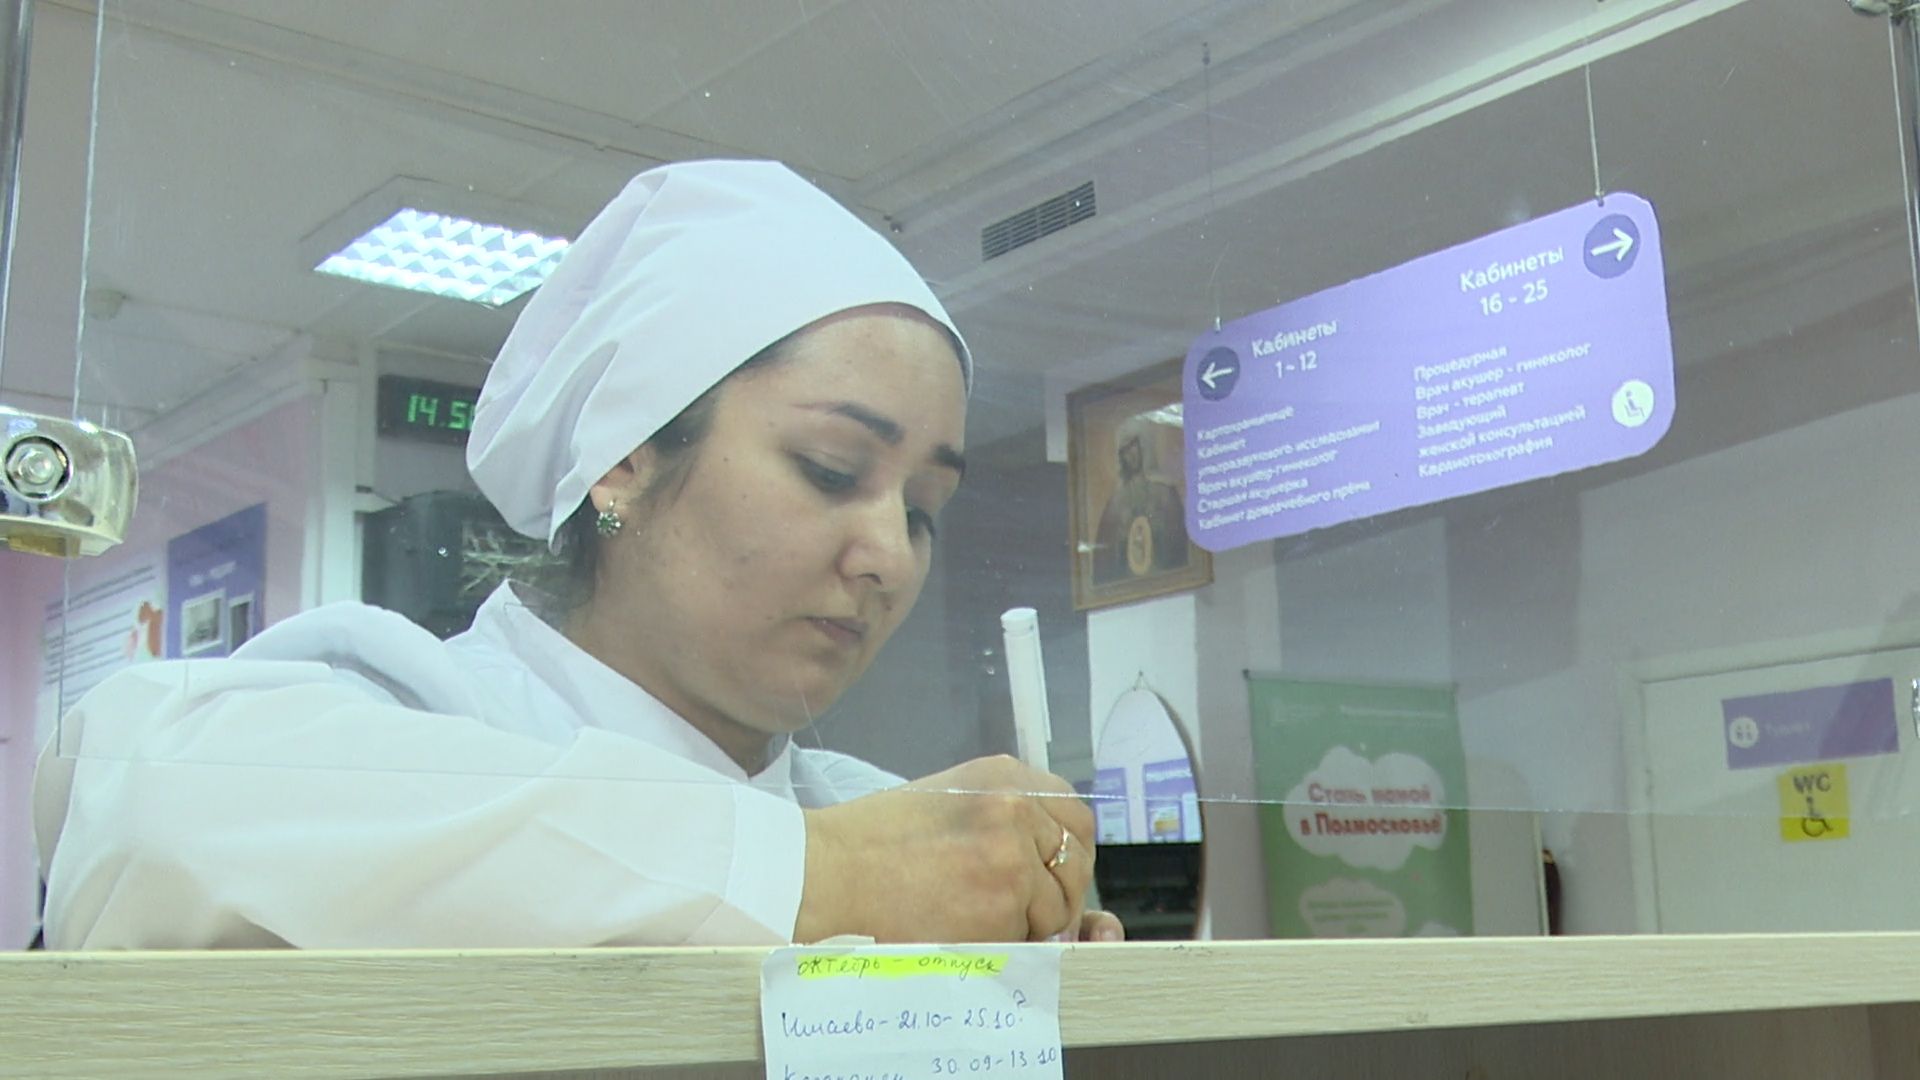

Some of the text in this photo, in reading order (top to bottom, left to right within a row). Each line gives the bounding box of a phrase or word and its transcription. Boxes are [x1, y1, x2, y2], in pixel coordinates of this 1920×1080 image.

[1460, 246, 1564, 292] Кабинеты
[1480, 294, 1503, 316] 16
[1523, 280, 1549, 305] 25
[1252, 321, 1337, 358] Кабинеты
[1275, 361, 1283, 379] 1
[1299, 351, 1318, 372] 12
[1414, 346, 1508, 381] Процедурная
[1415, 383, 1449, 401] Врач
[1451, 368, 1504, 392] акушер
[1516, 343, 1592, 374] гинеколог
[1416, 401, 1449, 420] Врач
[1463, 381, 1525, 407] терапевт
[1417, 404, 1508, 439] Заведующий
[1418, 404, 1587, 458] женской консультацией
[1198, 438, 1247, 461] Кабинет
[1418, 435, 1554, 478] Кардиотокография
[1198, 480, 1229, 496] Врач
[1248, 478, 1309, 500] акушерка
[1199, 510, 1246, 531] Кабинет
[1308, 783, 1366, 803] Стань
[1793, 773, 1831, 794] WC
[1300, 818, 1311, 835] в
[918, 956, 1001, 982] отпуск
